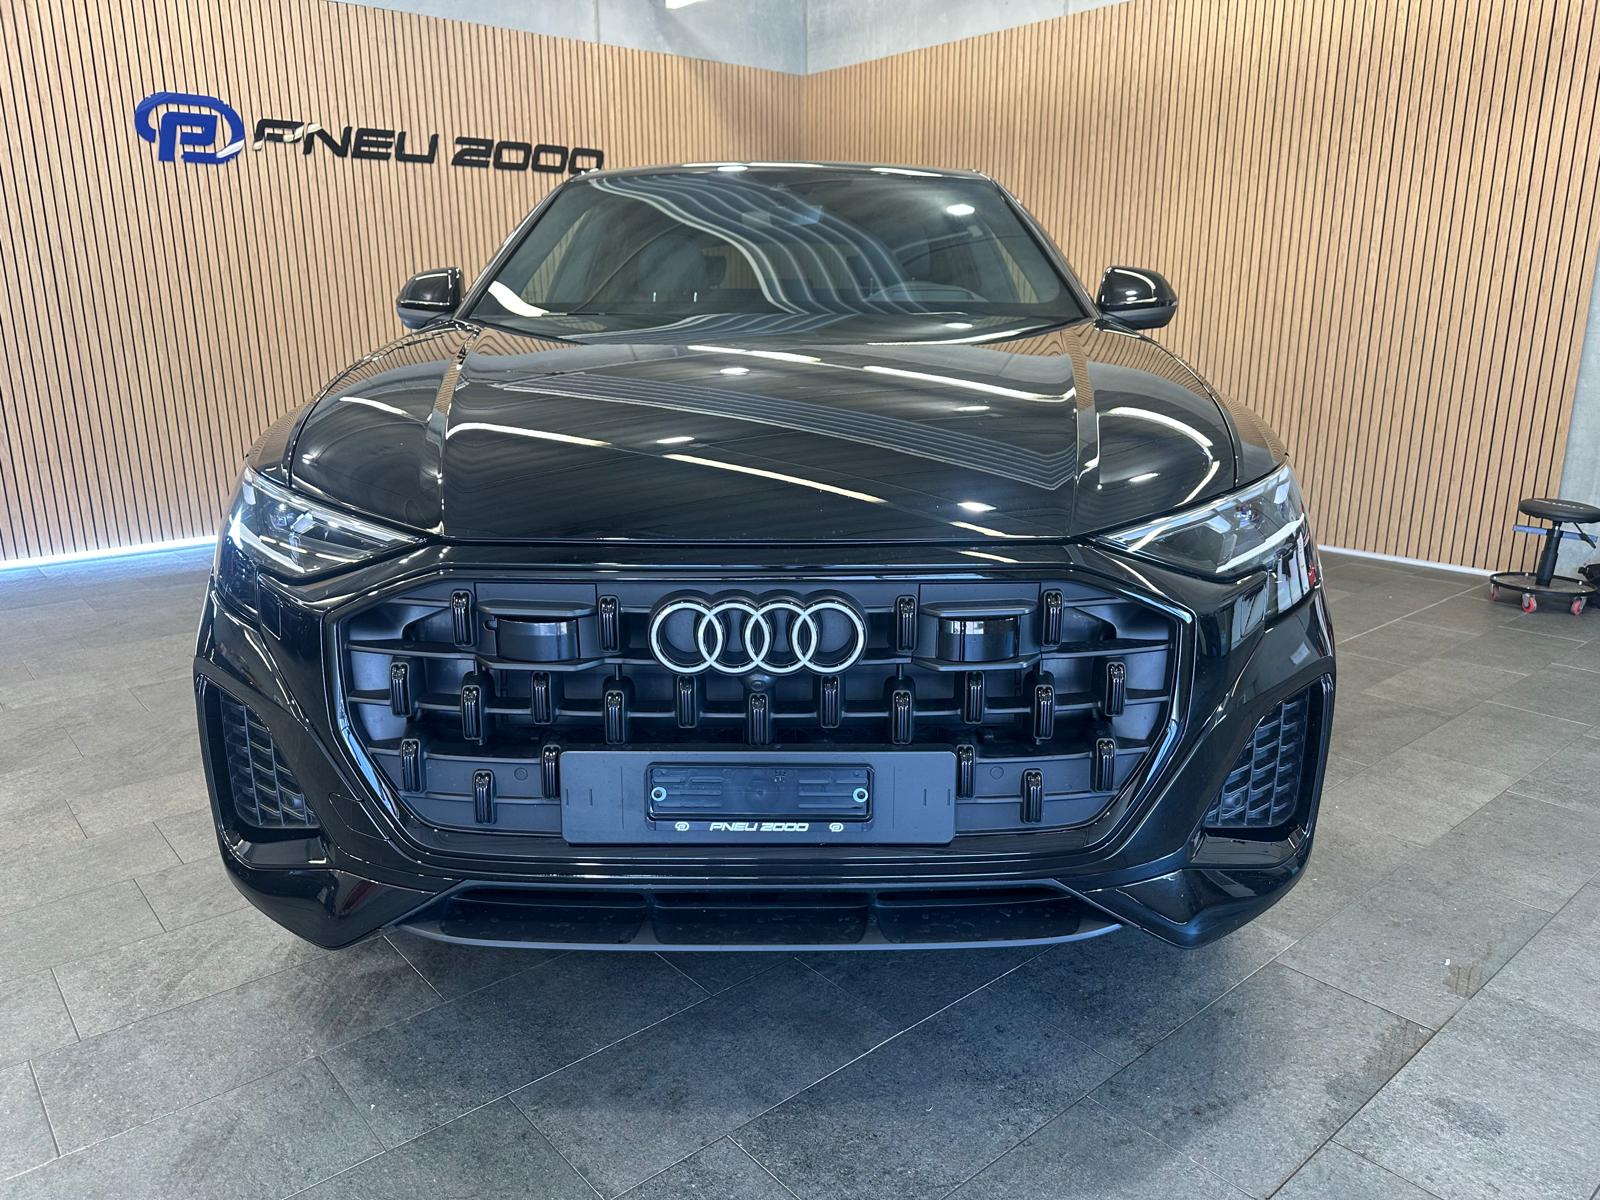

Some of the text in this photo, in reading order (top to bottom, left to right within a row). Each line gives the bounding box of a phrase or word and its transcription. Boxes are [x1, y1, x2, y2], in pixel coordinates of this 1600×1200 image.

[253, 118, 605, 174] PNEU 2000
[709, 822, 809, 832] PNEU 2000
